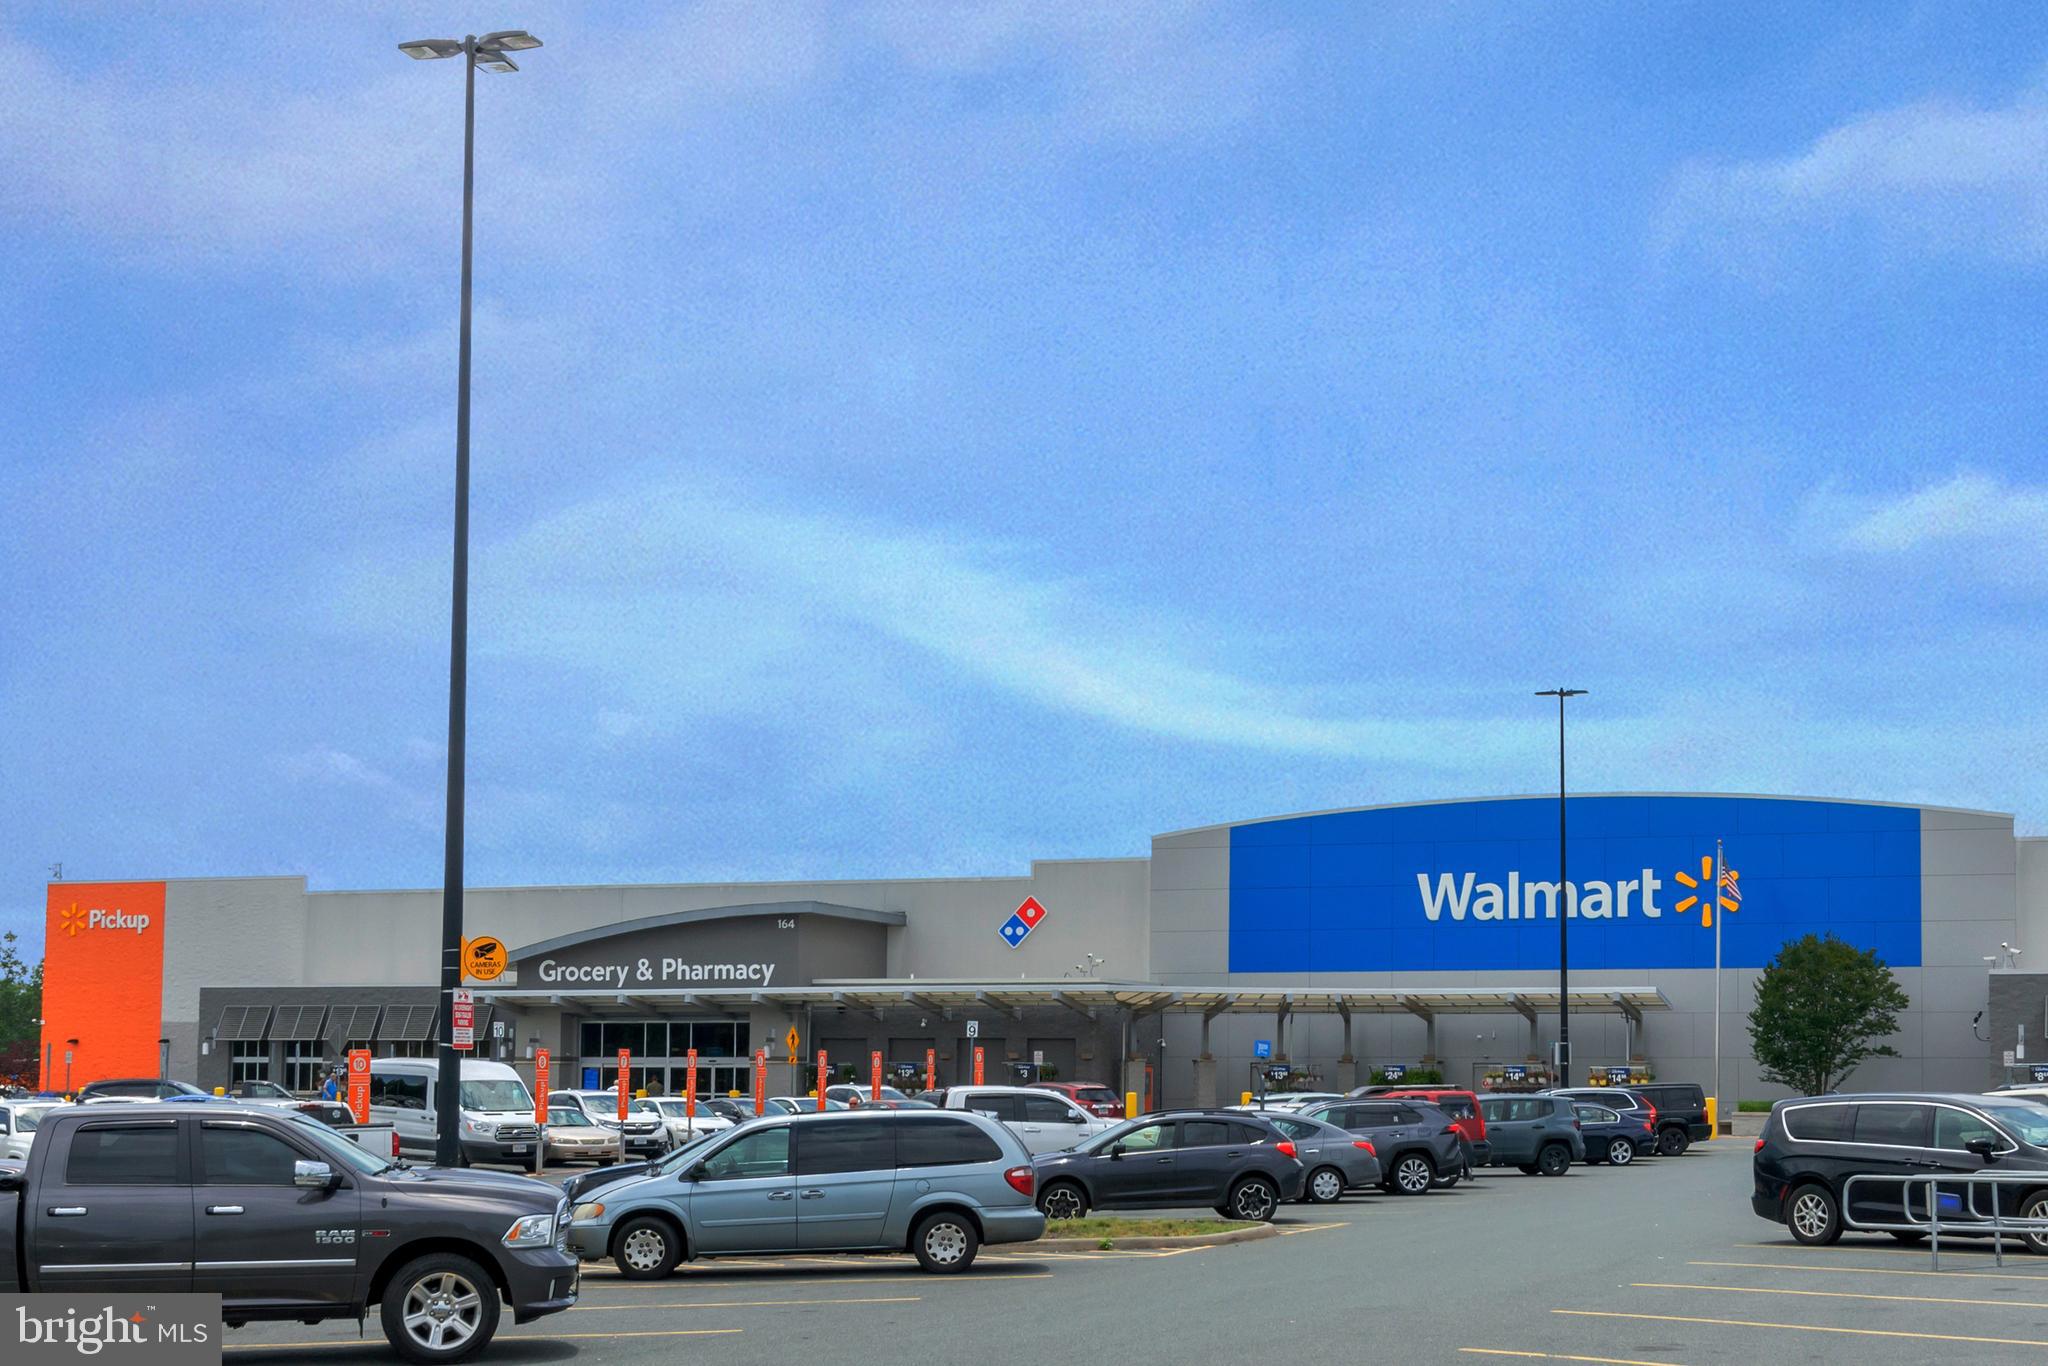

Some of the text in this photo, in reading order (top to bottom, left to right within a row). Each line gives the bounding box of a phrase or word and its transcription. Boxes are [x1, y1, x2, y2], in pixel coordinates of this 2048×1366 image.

[1417, 868, 1662, 921] Walmart
[89, 908, 150, 935] Pickup
[777, 919, 795, 929] 164
[538, 958, 775, 988] Grocery & Pharmacy
[494, 1026, 504, 1037] 10
[968, 1025, 976, 1037] 9
[355, 1060, 364, 1069] 10
[355, 1086, 365, 1118] Pickup
